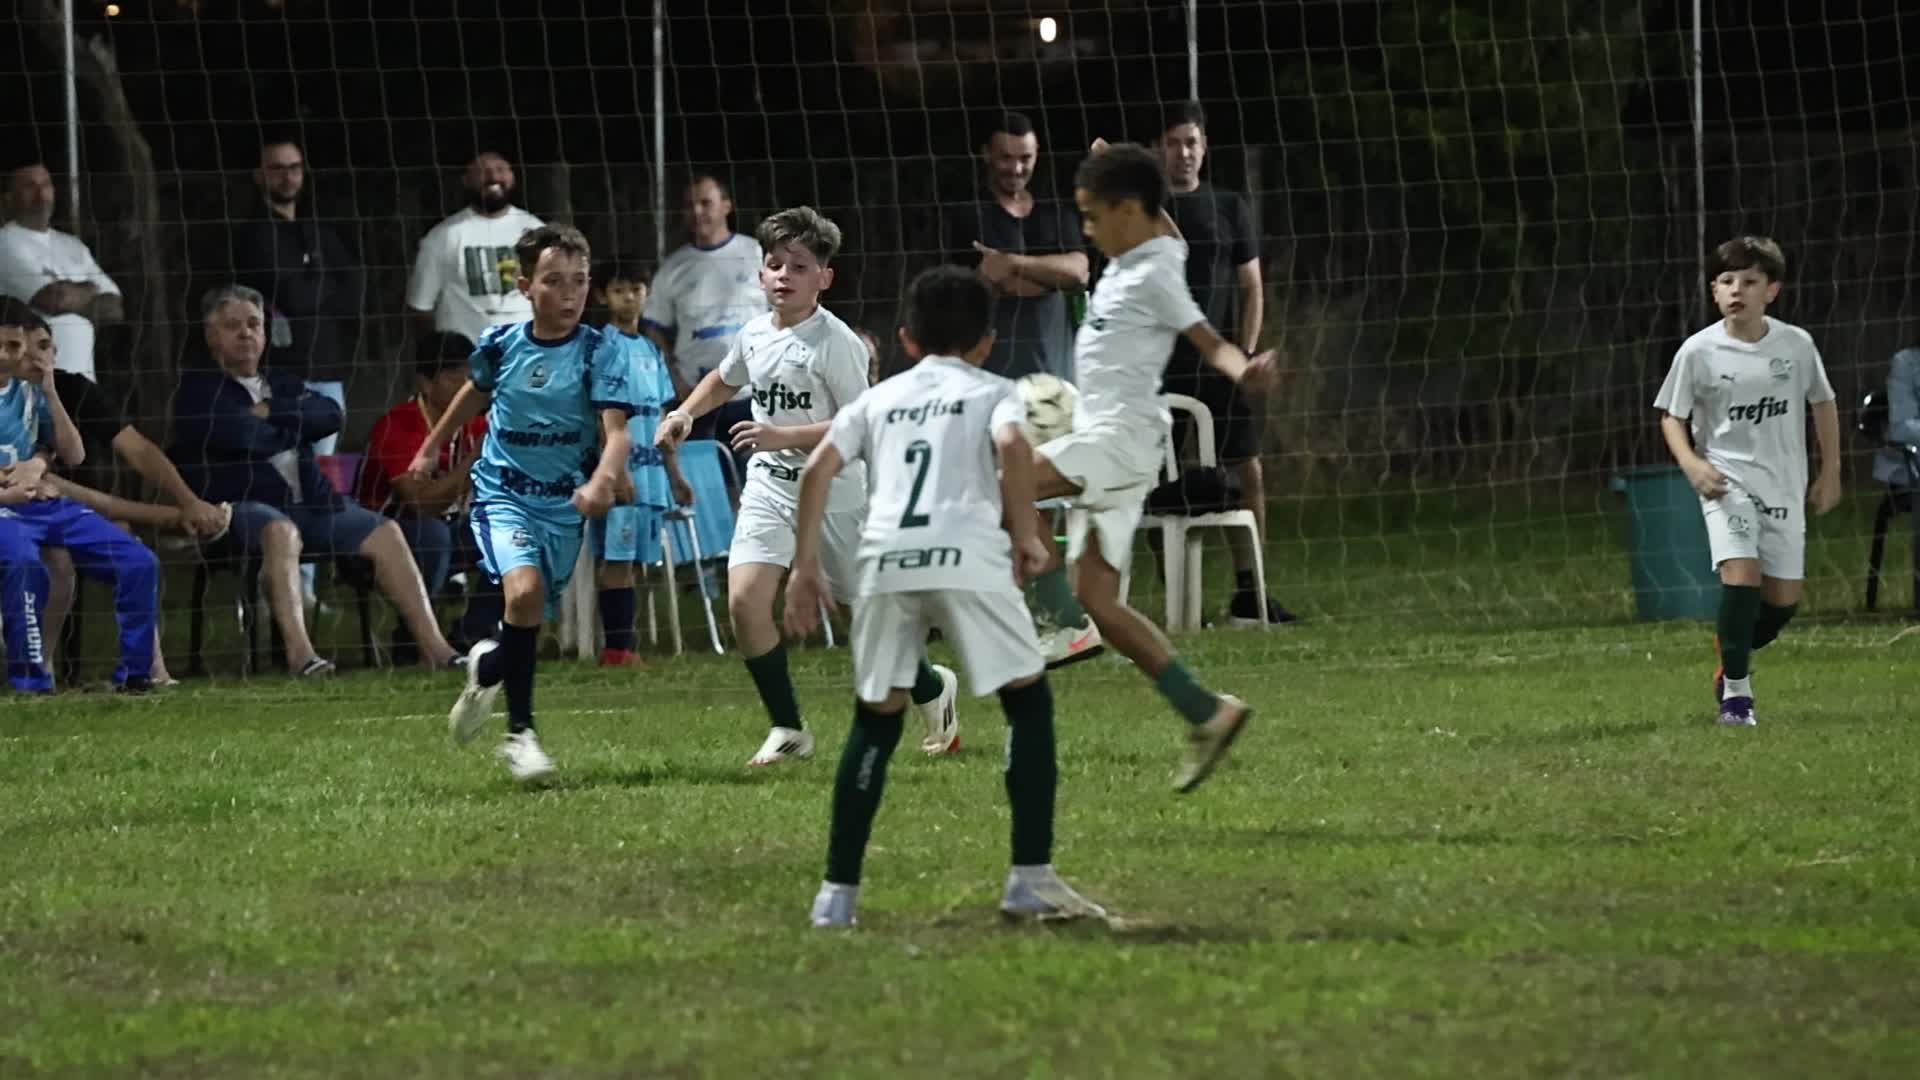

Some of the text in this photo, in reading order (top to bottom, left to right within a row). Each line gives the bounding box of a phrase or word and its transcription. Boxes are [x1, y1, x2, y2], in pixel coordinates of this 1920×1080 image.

[887, 399, 964, 427] crefisa
[899, 439, 932, 528] 2
[878, 547, 962, 573] Fam
